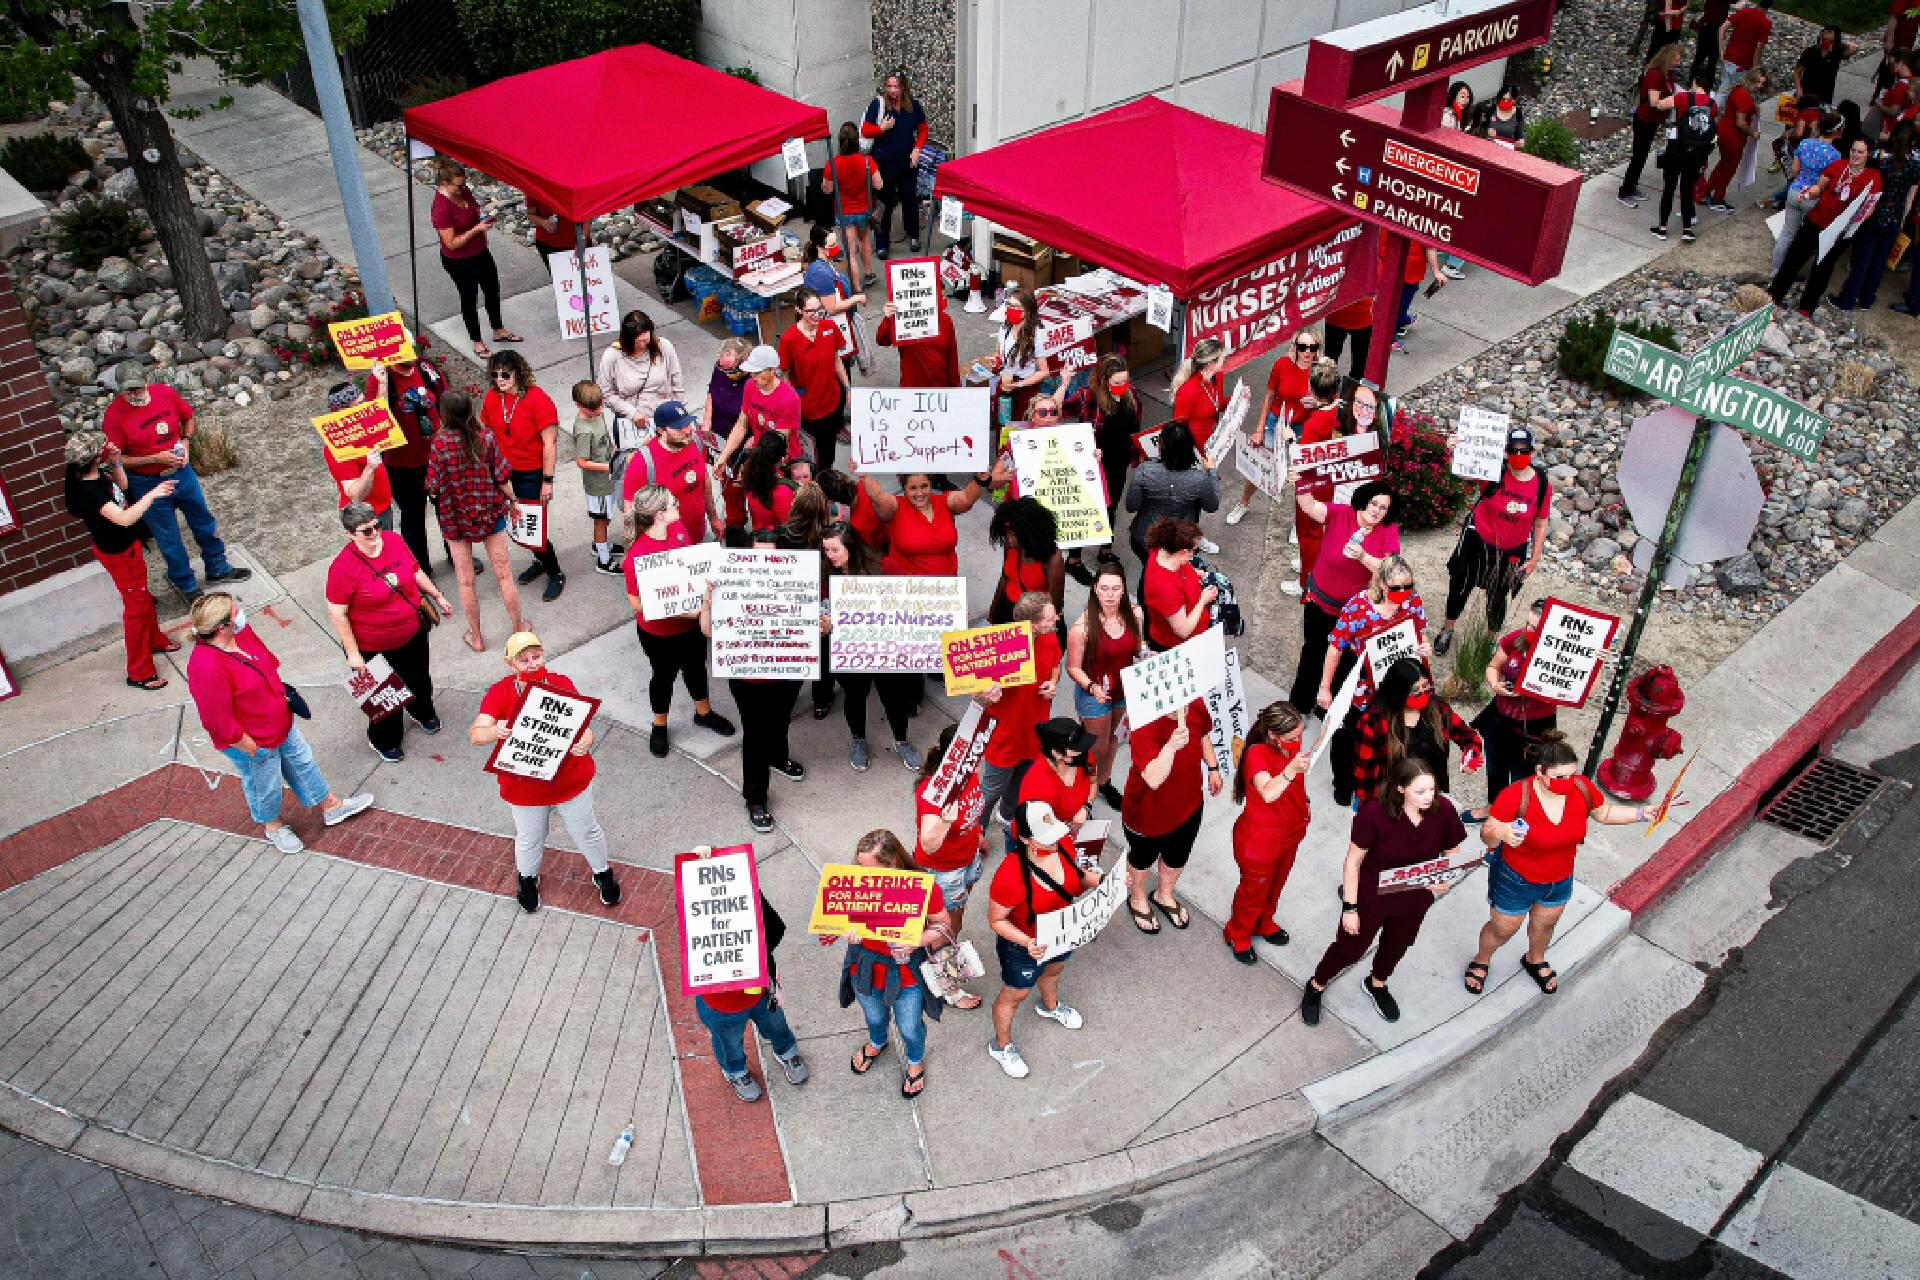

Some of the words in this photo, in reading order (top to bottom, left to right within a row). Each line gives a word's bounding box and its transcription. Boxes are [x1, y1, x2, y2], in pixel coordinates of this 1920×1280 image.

[1439, 15, 1519, 61] PARKING
[1387, 147, 1476, 188] EMERGENCY
[1378, 173, 1464, 219] HOSPITAL
[1373, 200, 1452, 241] PARKING
[870, 391, 901, 414] Our
[912, 393, 948, 412] ICU
[1645, 358, 1791, 438] ARINGTON
[1793, 412, 1823, 437] AVE
[870, 417, 890, 431] is
[907, 419, 935, 432] on
[858, 434, 902, 464] Life
[1786, 432, 1816, 456] 600
[1040, 466, 1077, 479] NURSES
[838, 611, 954, 627] 2019:Nurses
[1560, 614, 1594, 635] RNs
[972, 626, 1023, 648] STRIKE
[1376, 631, 1405, 650] RNs
[1544, 634, 1595, 658] STRIKE
[1533, 658, 1589, 680] PATIENT
[1538, 672, 1574, 690] CARE
[540, 696, 574, 717] RNs
[521, 715, 574, 739] STRIKE
[507, 737, 563, 759] PATIENT
[512, 751, 548, 767] CARE
[697, 865, 736, 885] RNs
[829, 876, 854, 888] ON
[860, 876, 924, 889] STRIKE
[710, 885, 727, 896] on
[828, 890, 851, 900] FOR
[854, 890, 882, 900] SAFE
[691, 895, 749, 917] STRIKE
[826, 901, 881, 913] PATIENT
[884, 903, 919, 914] CARE
[711, 917, 732, 930] for
[691, 929, 753, 950] PATIENT
[702, 948, 744, 966] CARE
